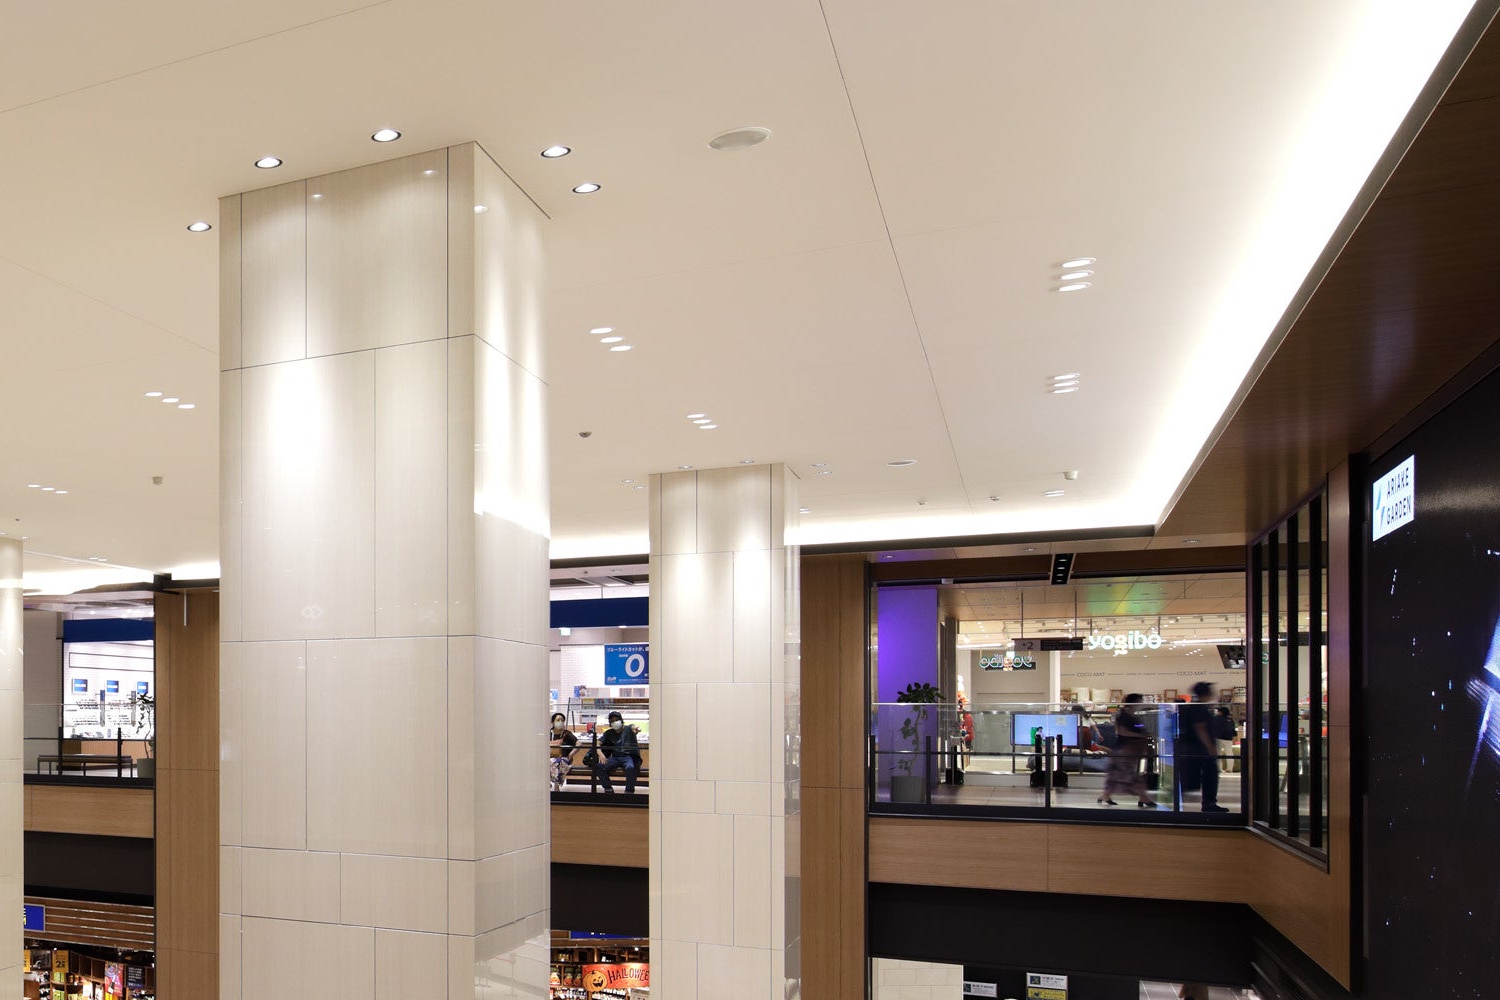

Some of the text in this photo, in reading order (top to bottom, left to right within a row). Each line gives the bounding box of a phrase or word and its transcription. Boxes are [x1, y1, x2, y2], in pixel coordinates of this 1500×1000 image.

[1386, 466, 1409, 500] ARIAKE
[1386, 494, 1412, 525] GARDEN
[1088, 630, 1162, 655] yogibo
